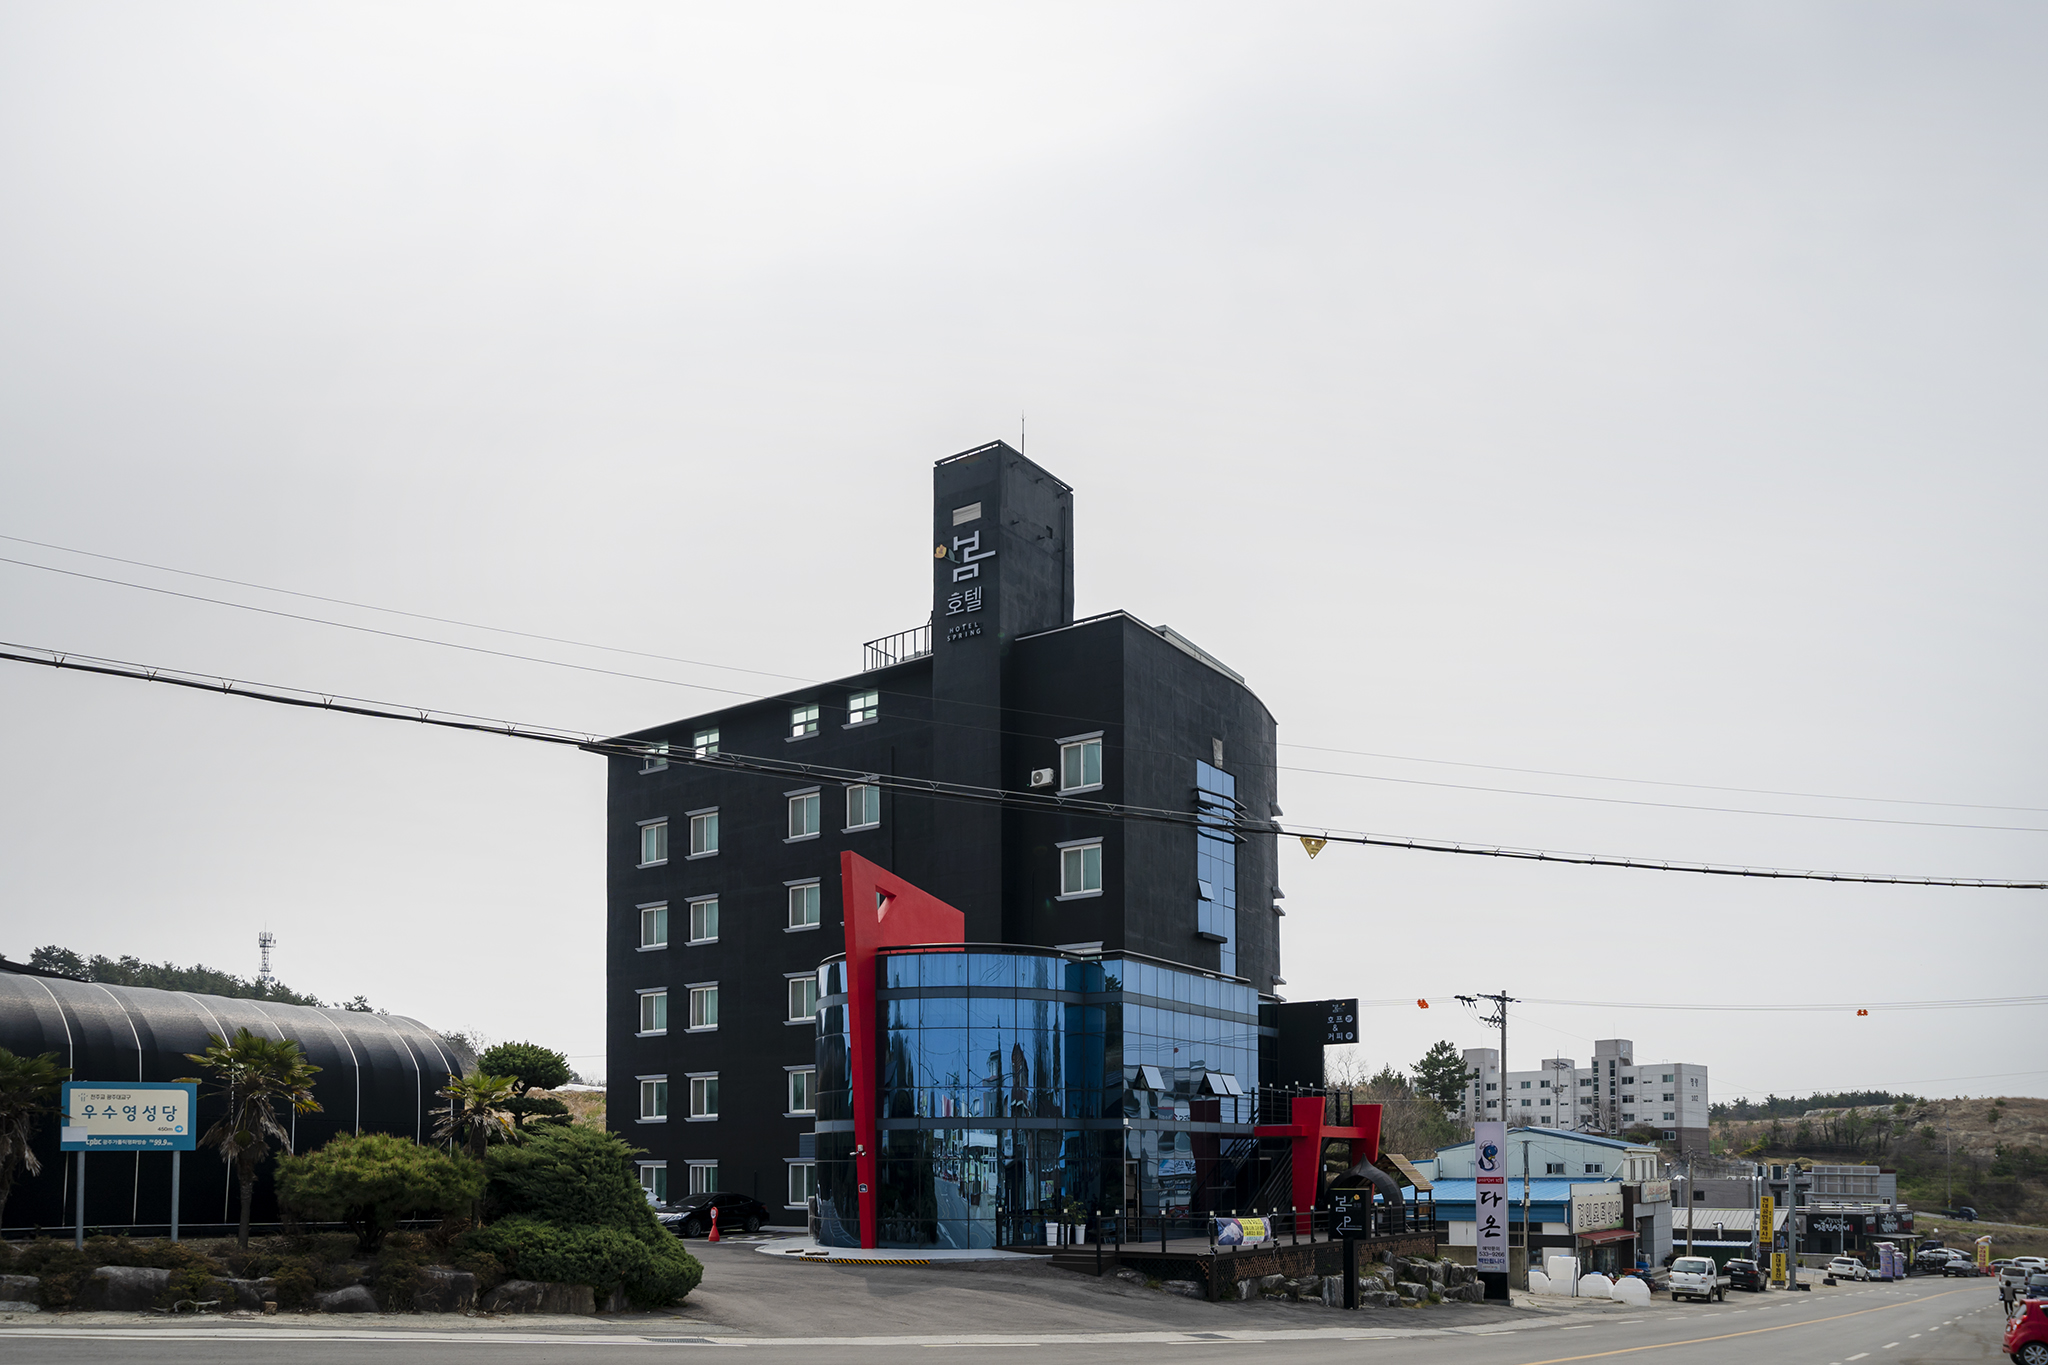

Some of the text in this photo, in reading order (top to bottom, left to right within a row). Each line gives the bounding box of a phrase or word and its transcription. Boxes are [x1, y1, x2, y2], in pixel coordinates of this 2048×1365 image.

[953, 530, 996, 583] 봄
[946, 586, 982, 616] 호텔
[949, 622, 978, 634] HOTEL
[946, 628, 981, 642] SPRING
[1327, 1016, 1343, 1024] 호프
[1327, 1032, 1343, 1041] 커피
[81, 1104, 177, 1122] 우수영성당
[1343, 1215, 1351, 1227] P
